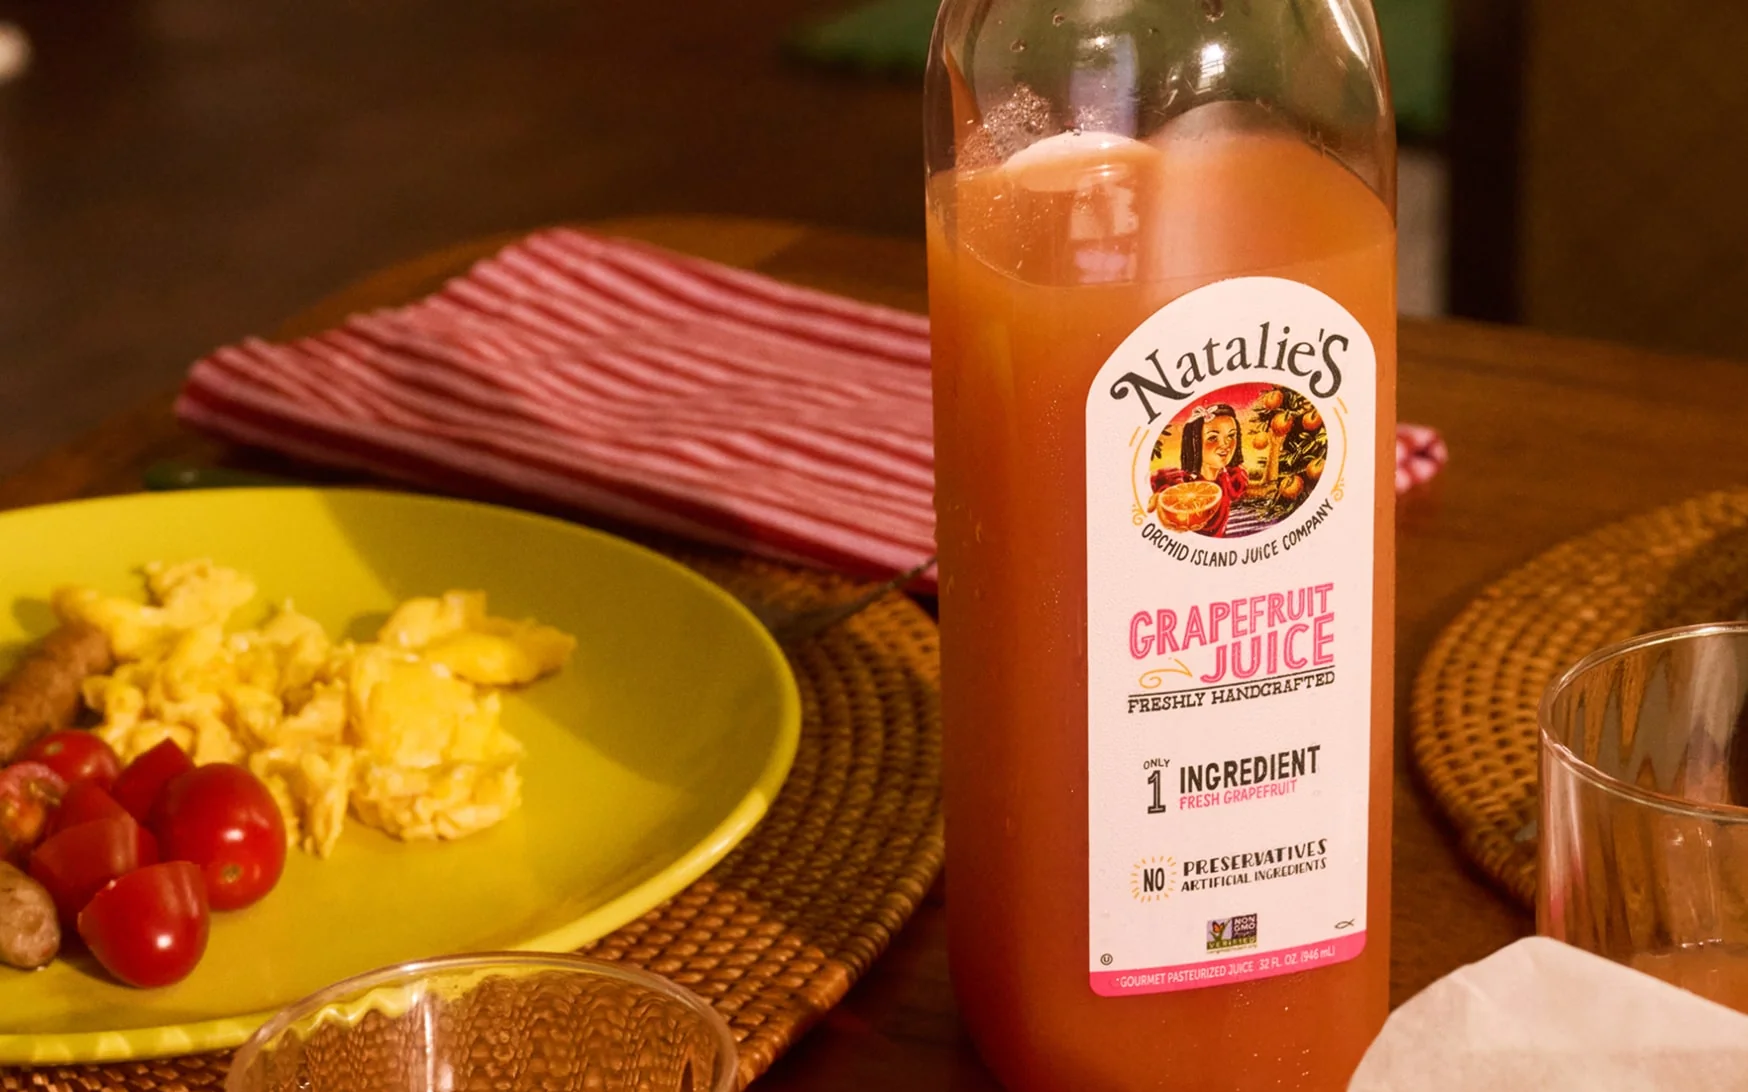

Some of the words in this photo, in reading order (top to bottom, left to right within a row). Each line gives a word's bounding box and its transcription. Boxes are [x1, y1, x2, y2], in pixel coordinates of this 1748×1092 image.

[1110, 322, 1349, 424] Natalie'S
[1141, 523, 1189, 561] ORCHID
[1190, 549, 1238, 567] ISLAND
[1282, 501, 1334, 550] COMPANY
[1129, 582, 1334, 660] GRAPEFRUIT
[1200, 612, 1335, 684] JUICE
[1127, 692, 1206, 713] FRESHLY
[1211, 671, 1335, 704] HANDCRAFTED
[1143, 758, 1170, 769] ONLY
[1147, 770, 1166, 814] 1
[1180, 745, 1321, 793] INGREDIENT
[1179, 794, 1220, 810] FRESH
[1223, 779, 1297, 804] GRAPEFRUIT
[1180, 872, 1251, 892] ARTIFICIAL
[1254, 858, 1327, 880] INGREDIENTS
[1183, 838, 1328, 876] PRESERVATIVES
[1143, 868, 1165, 892] NO
[1234, 916, 1256, 925] NON
[1234, 922, 1256, 932] GMO
[1167, 965, 1227, 984] PASTEURIZED
[1228, 960, 1254, 976] JUICE
[1258, 958, 1270, 971] 32
[1300, 947, 1319, 963] (946
